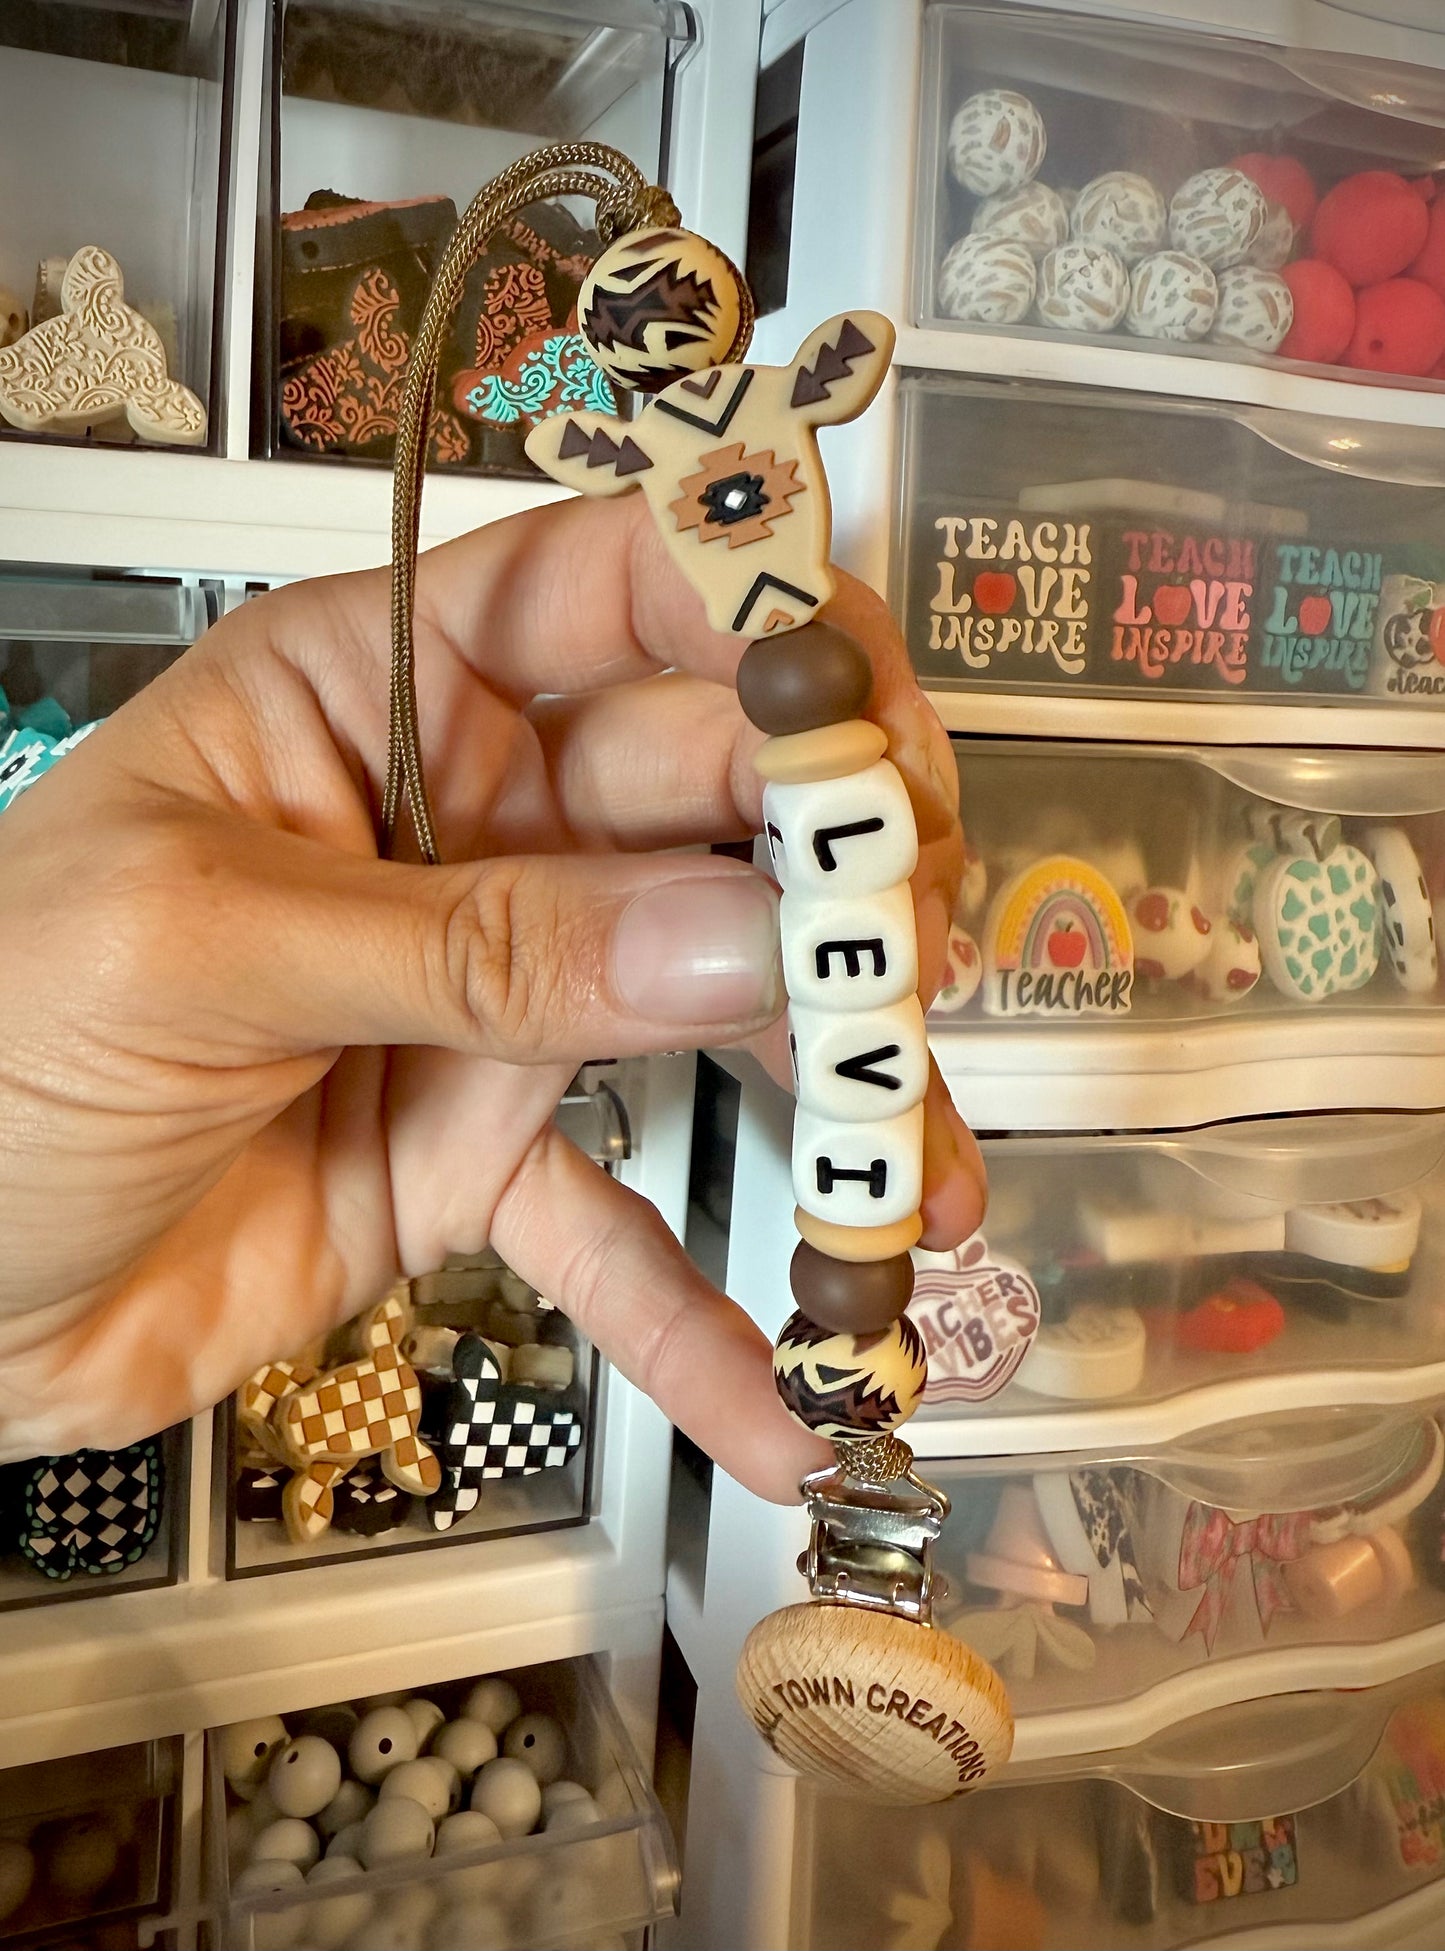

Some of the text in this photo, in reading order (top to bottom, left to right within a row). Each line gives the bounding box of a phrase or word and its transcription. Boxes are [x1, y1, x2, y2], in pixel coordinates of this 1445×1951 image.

[935, 517, 1092, 565] TEACH
[1122, 530, 1255, 580] TEACH
[1277, 545, 1382, 591] TEACH
[930, 561, 1091, 618] LOVE
[1113, 574, 1253, 630] LOVE
[1265, 586, 1379, 639] LOVE
[929, 615, 1087, 674] INSPIRE
[1111, 626, 1249, 684] INSPIRE
[1261, 634, 1369, 689] INSPIRE
[812, 817, 902, 1198] LEVI
[918, 1272, 1024, 1356] ACHER
[932, 1295, 1038, 1377] VIBES
[773, 1675, 986, 1782] TOWN CREATIONS
